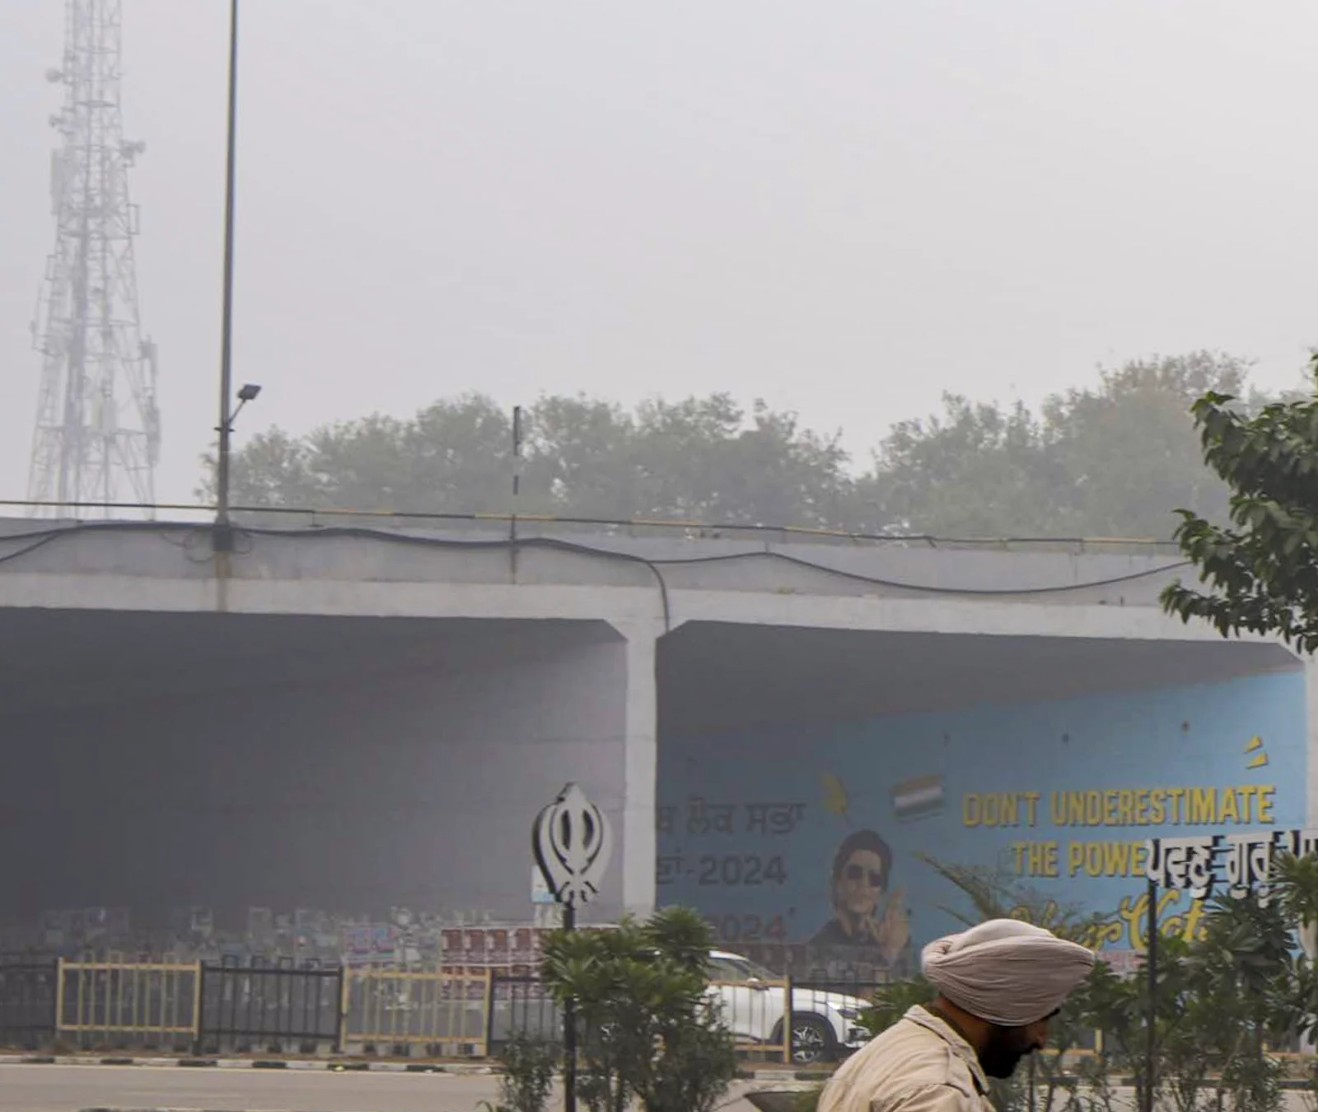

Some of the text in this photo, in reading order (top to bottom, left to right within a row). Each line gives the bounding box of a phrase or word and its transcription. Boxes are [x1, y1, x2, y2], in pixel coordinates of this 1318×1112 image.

[1051, 785, 1277, 828] UNDERESTIMATE
[1012, 839, 1147, 879] THE POWE
